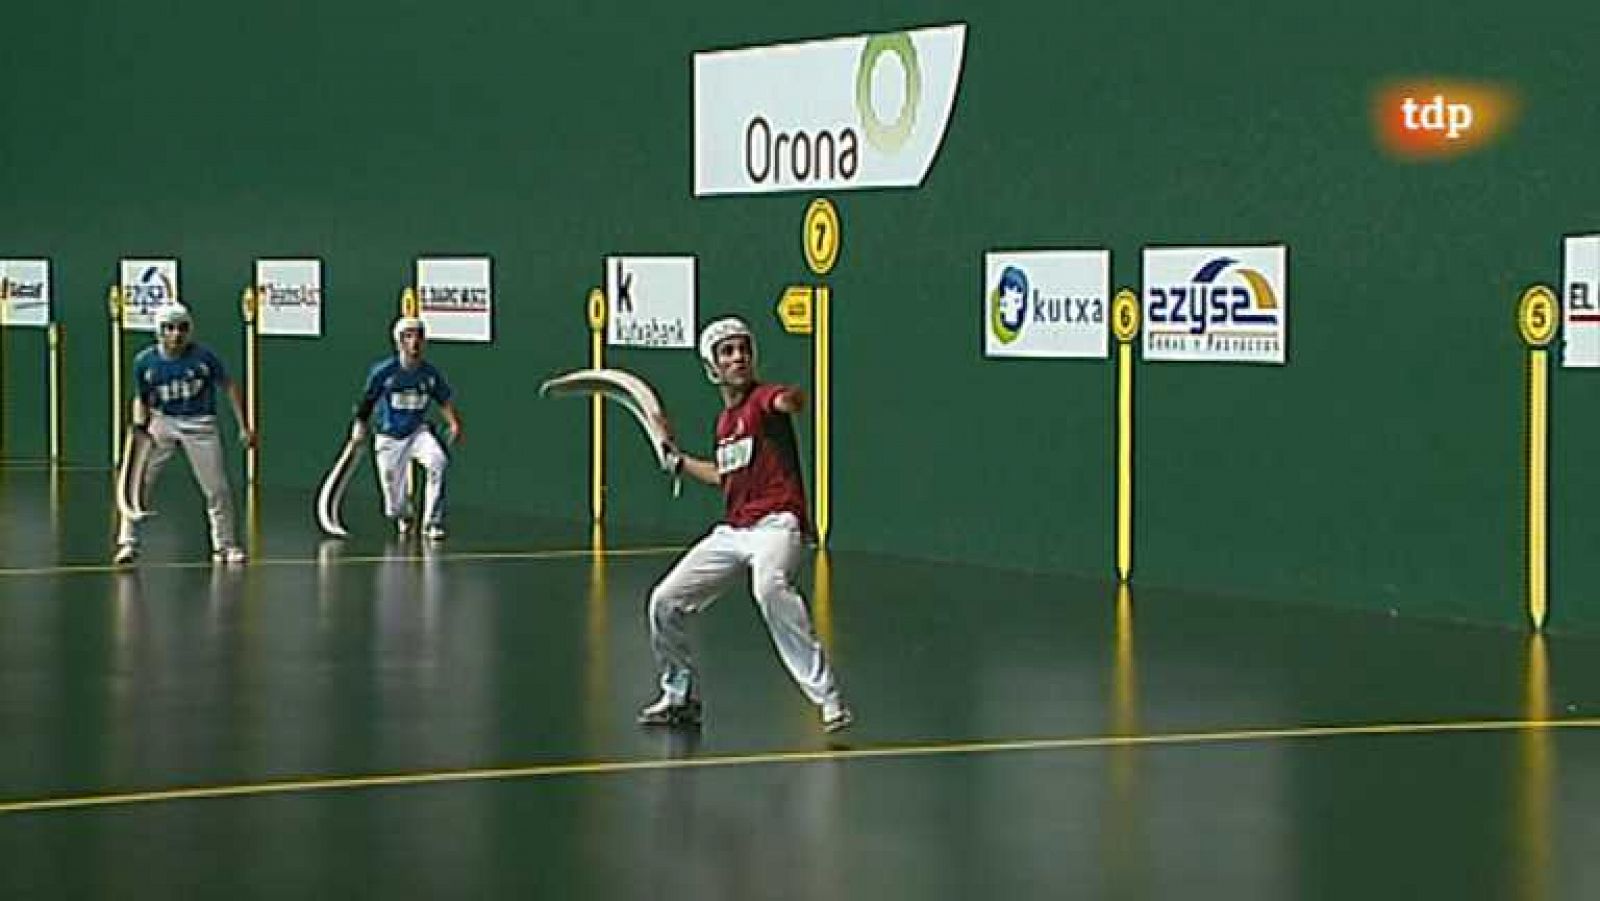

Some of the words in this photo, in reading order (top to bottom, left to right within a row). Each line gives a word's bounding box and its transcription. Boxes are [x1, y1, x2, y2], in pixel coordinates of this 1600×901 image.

[745, 116, 859, 183] Orona
[816, 223, 827, 251] 7
[616, 258, 633, 313] k
[1570, 283, 1594, 309] EL
[1033, 290, 1103, 324] kutxa
[1120, 303, 1130, 329] 6
[1532, 303, 1546, 328] 5
